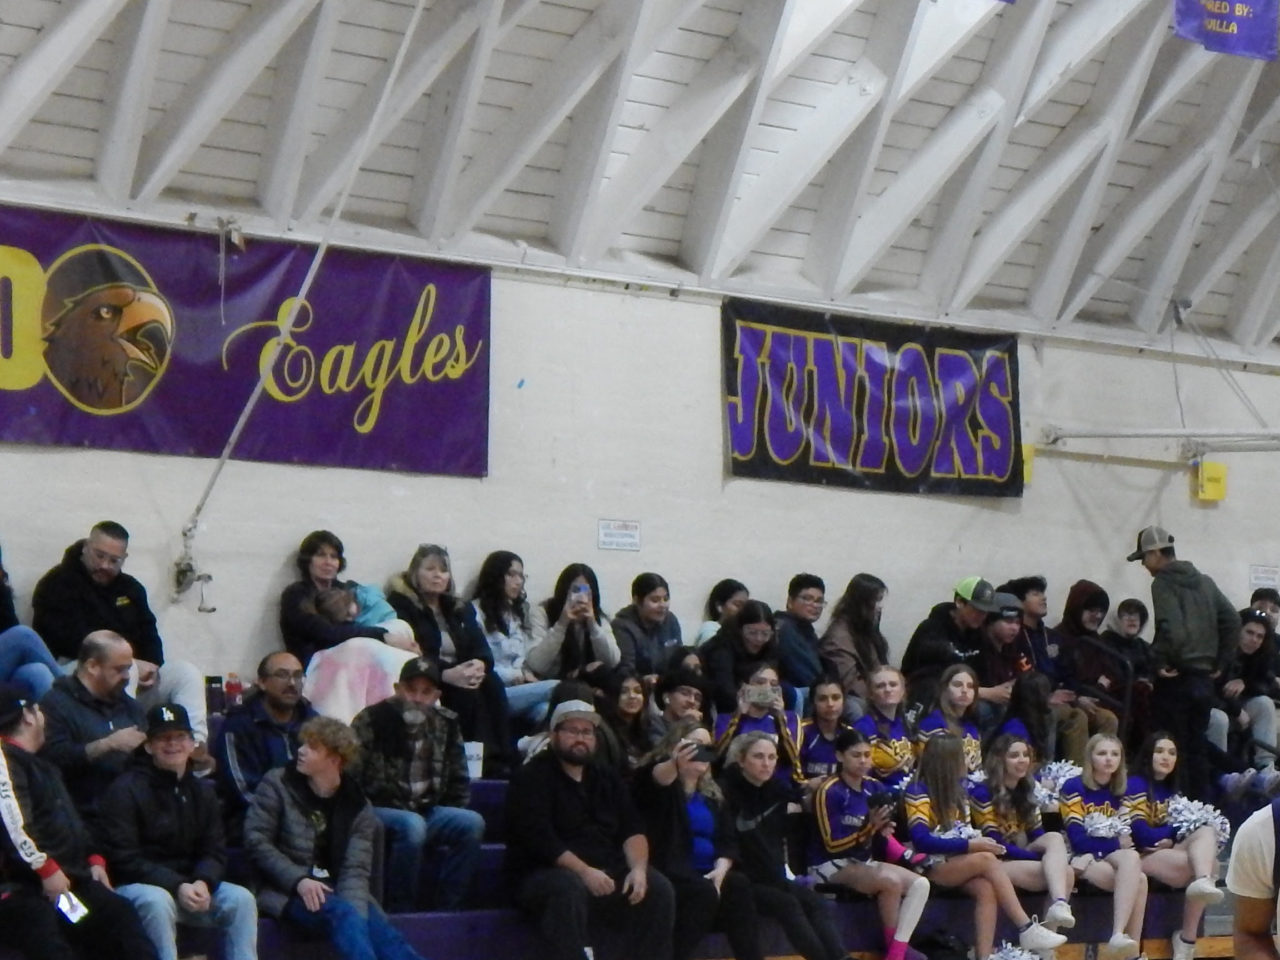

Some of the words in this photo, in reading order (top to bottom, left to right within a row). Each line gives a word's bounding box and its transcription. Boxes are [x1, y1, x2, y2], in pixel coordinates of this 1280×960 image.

[222, 283, 482, 434] Eagles
[727, 320, 1015, 482] JUNIORS
[162, 706, 174, 722] LA
